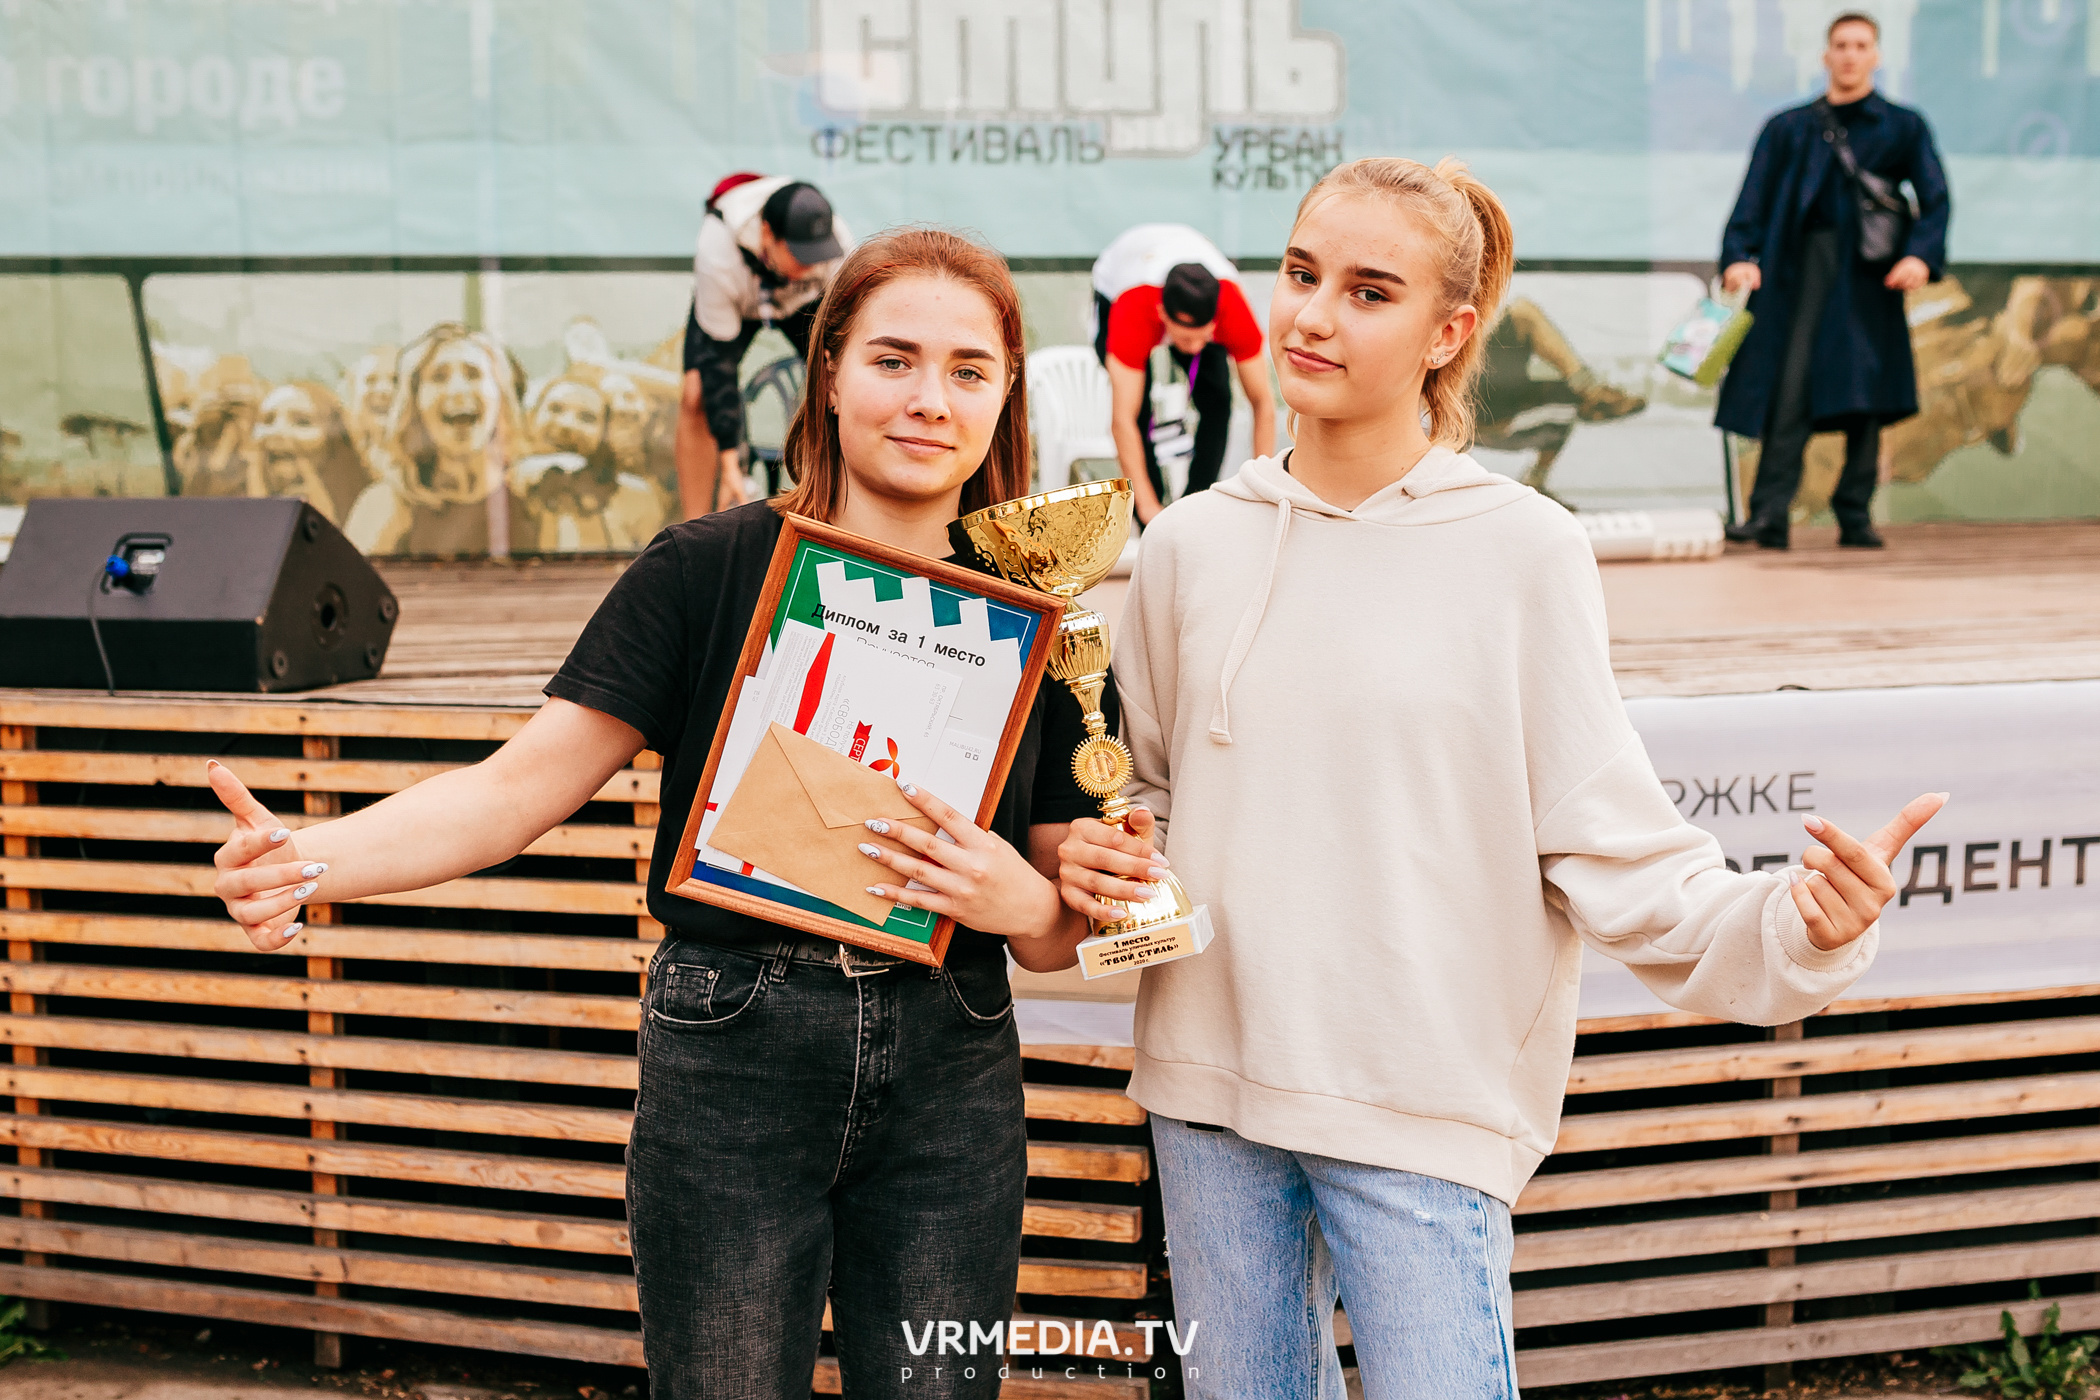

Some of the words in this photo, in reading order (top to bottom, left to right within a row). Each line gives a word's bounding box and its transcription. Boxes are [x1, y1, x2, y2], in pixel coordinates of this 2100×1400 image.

[45, 54, 347, 133] городе
[811, 124, 1106, 165] ФЕСТИВАЛЬ
[1213, 126, 1344, 163] УРБАН
[811, 603, 881, 636] Диплом
[887, 629, 909, 644] за
[918, 635, 927, 649] 1
[933, 643, 987, 667] место
[825, 698, 850, 750] «СВОБОД
[1100, 952, 1135, 966] «ТВОЙ
[1137, 944, 1179, 958] СТИЛЬ»
[1113, 941, 1119, 949] 1
[1121, 935, 1151, 947] место
